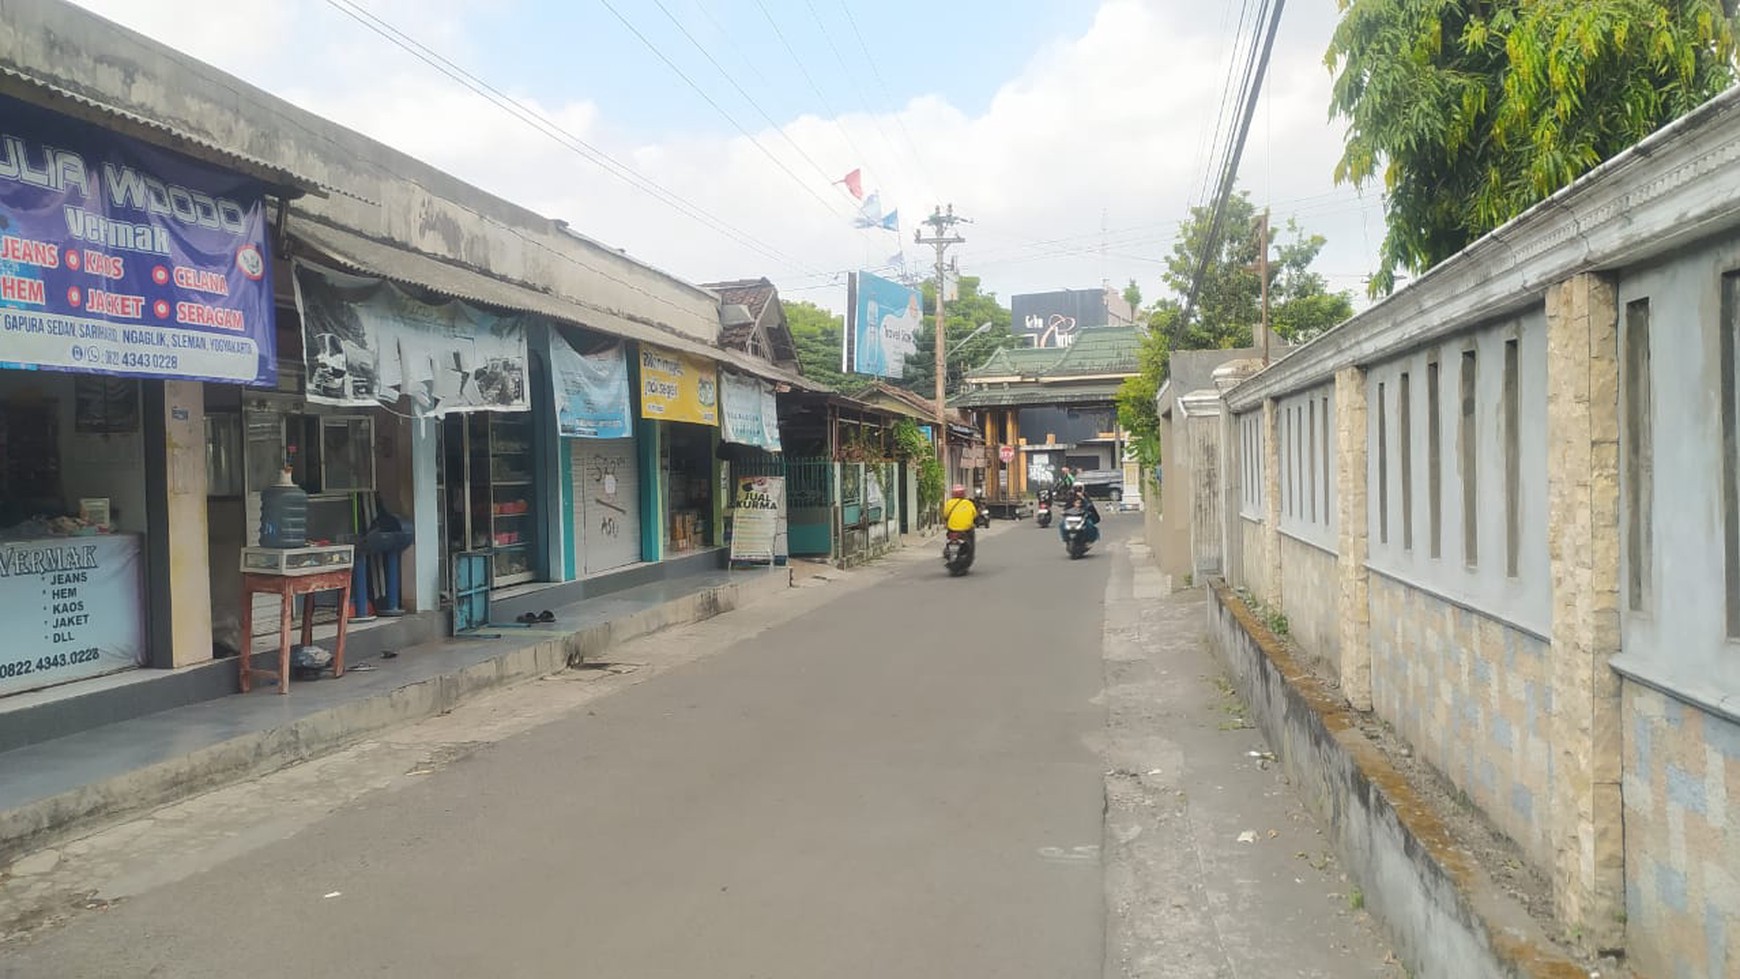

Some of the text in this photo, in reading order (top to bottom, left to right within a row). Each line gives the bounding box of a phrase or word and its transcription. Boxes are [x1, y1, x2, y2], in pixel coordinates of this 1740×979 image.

[2, 237, 229, 296] JEANS KAOS CELANA
[2, 276, 245, 331] HEM JACKET SERAGAM
[4, 314, 45, 333] GAPURA
[122, 352, 151, 367] 4343
[153, 354, 178, 369] 0228
[745, 492, 773, 502] JUAL
[736, 501, 778, 510] KURMA
[0, 546, 99, 577] VERMAK
[50, 572, 88, 585] JEANS
[52, 588, 78, 600] HEM
[52, 601, 85, 614] KAOS
[52, 614, 90, 628] JAKET
[53, 632, 75, 643] DLL
[0, 648, 100, 678] 0822.4343.0228
